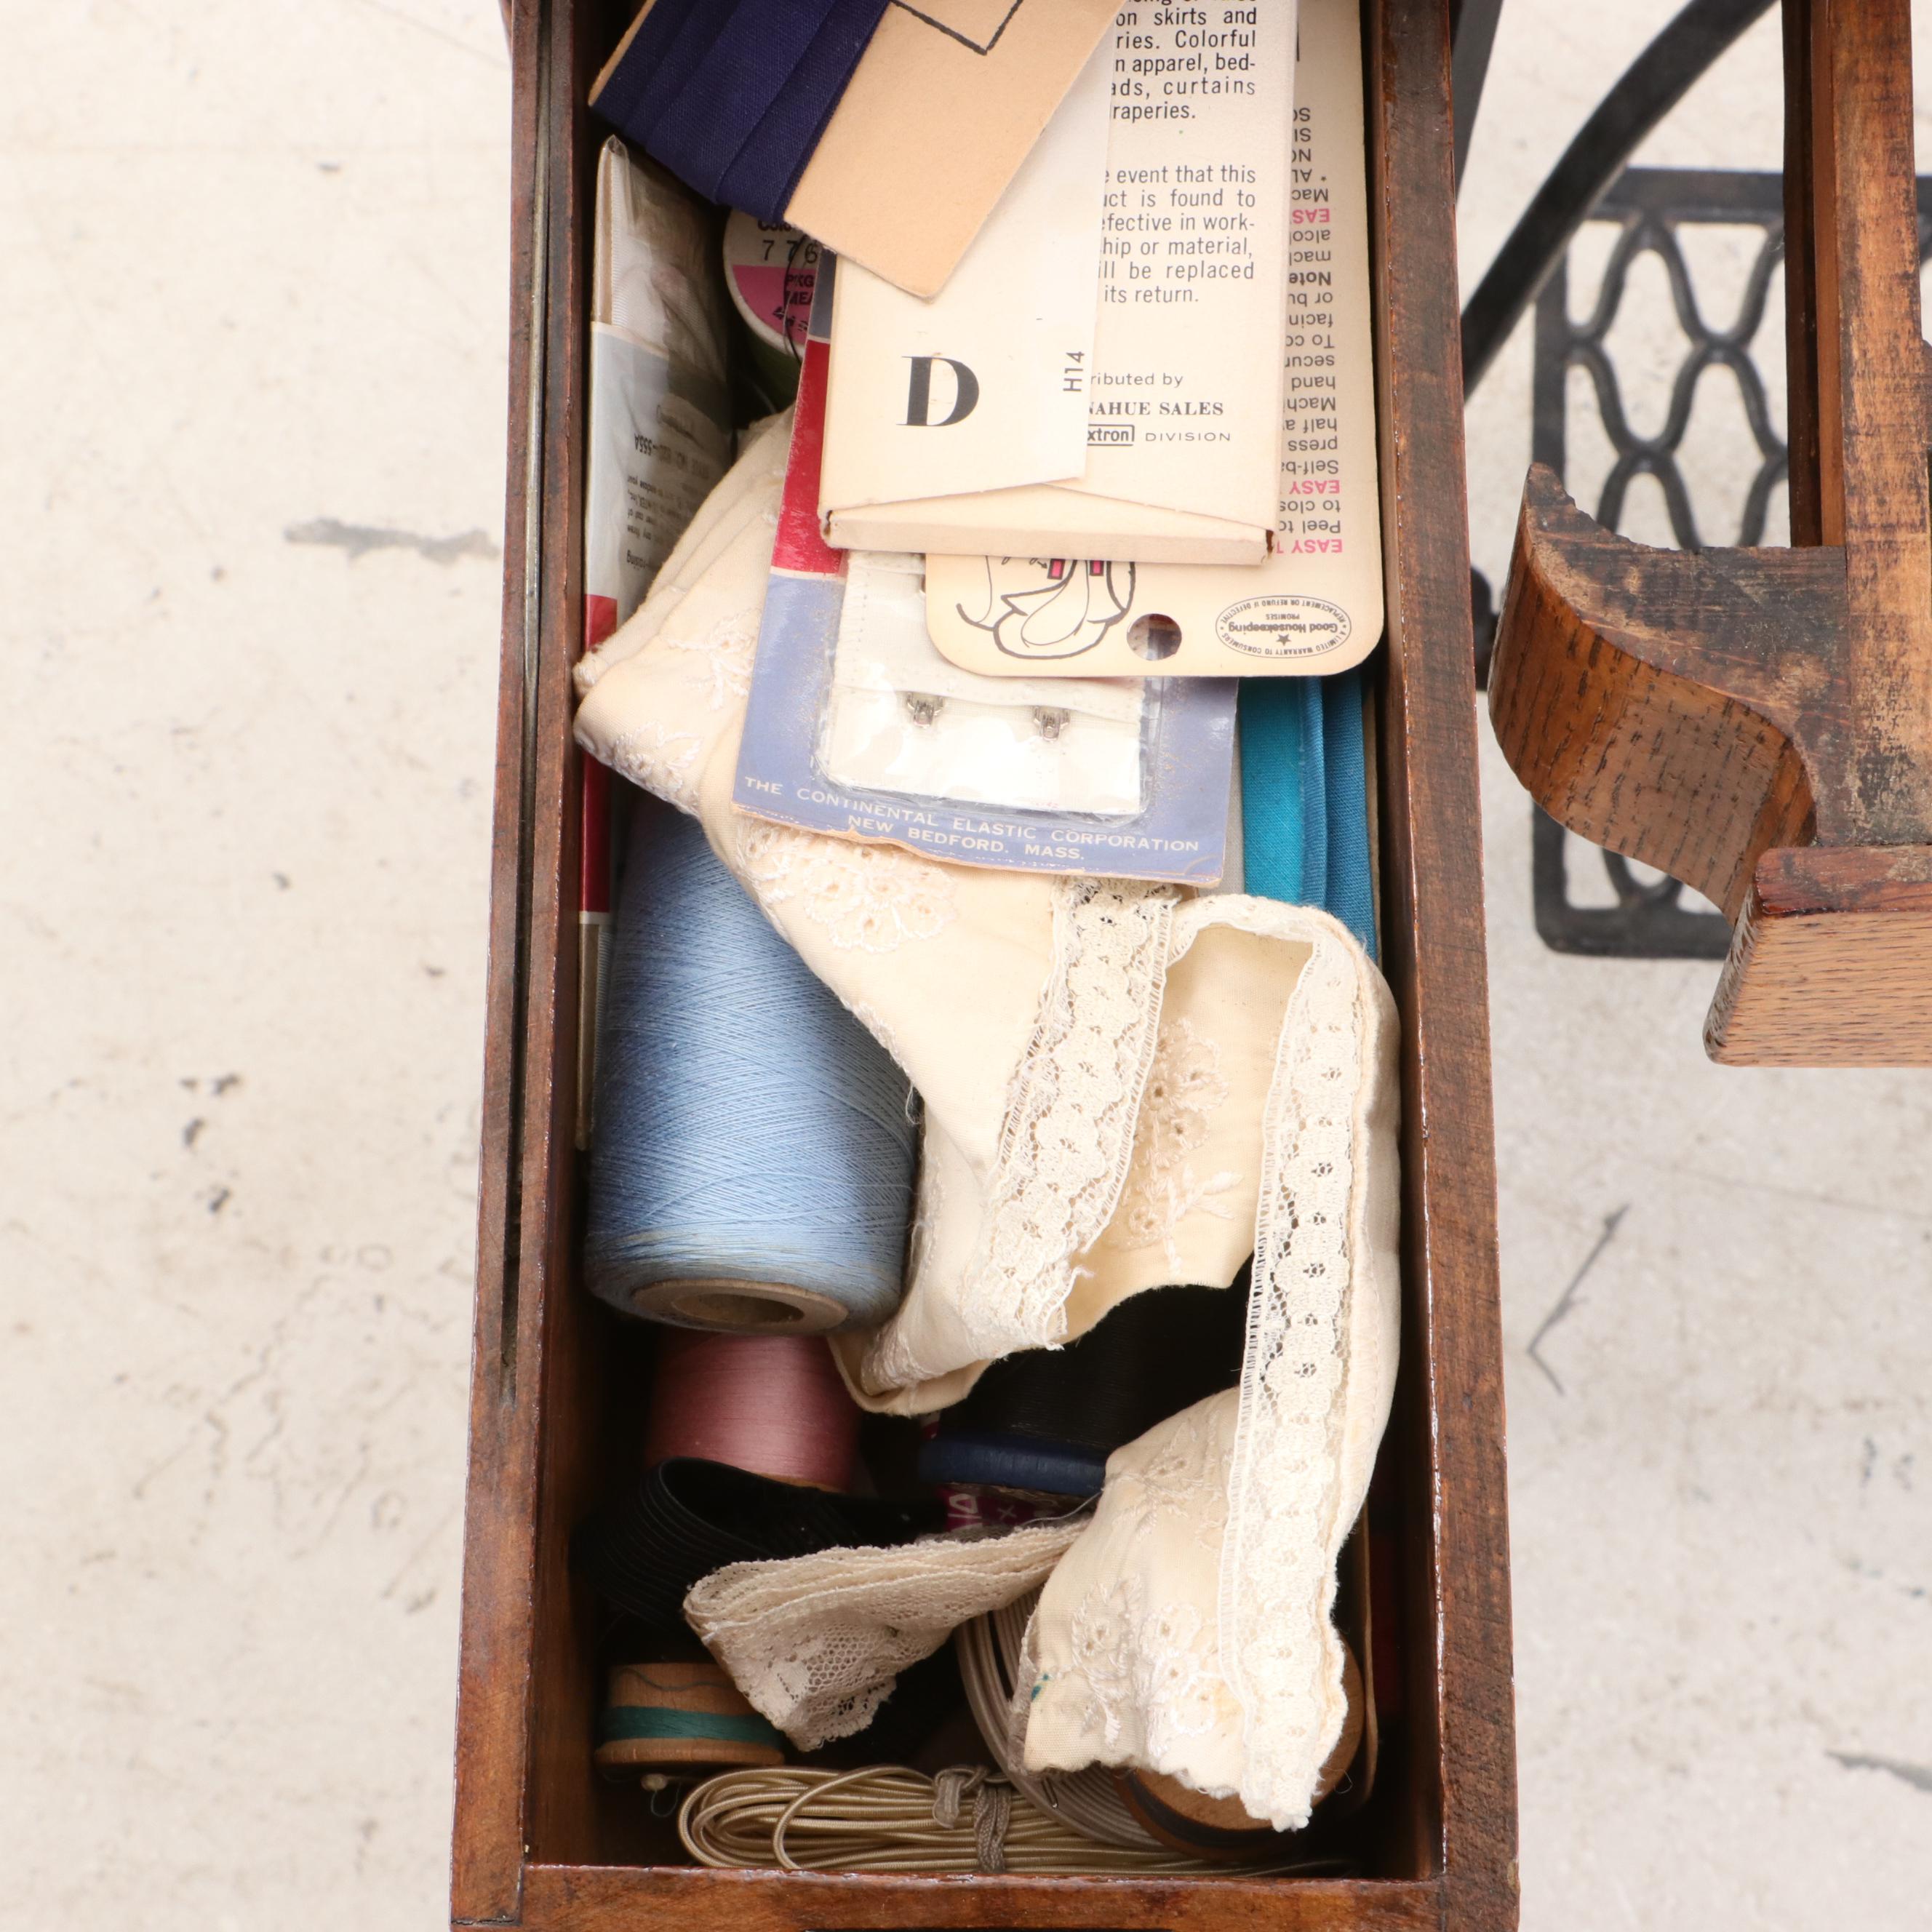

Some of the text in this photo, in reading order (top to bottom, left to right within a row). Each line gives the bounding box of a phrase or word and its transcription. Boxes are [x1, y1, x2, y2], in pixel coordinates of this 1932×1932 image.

[1116, 7, 1257, 26] on skirts and
[1117, 29, 1256, 49] ries. Colorful
[1115, 52, 1256, 76] n apparel, bed-
[1164, 76, 1256, 95] curtains
[1113, 100, 1196, 124] raperies.
[1117, 166, 1168, 183] event
[1175, 164, 1214, 183] that
[1221, 164, 1256, 183] this
[1141, 189, 1157, 207] is
[1170, 188, 1224, 207] found
[1237, 188, 1256, 208] to
[1181, 212, 1196, 231] in
[1203, 212, 1255, 231] work-
[1290, 208, 1330, 224] EAS
[1141, 241, 1159, 255] or
[1168, 236, 1253, 260] material,
[1129, 261, 1151, 279] be
[1166, 260, 1254, 282] replaced
[1104, 284, 1199, 303] its return.
[1315, 292, 1333, 304] or
[1312, 335, 1335, 349] To
[1063, 351, 1085, 392] H14
[1090, 372, 1183, 388] ributed by
[895, 356, 980, 427] D
[1292, 376, 1336, 391] hand
[1159, 402, 1224, 416] SALES
[1283, 397, 1336, 412] Mach
[1304, 418, 1337, 434] half
[1145, 432, 1232, 442] DIVISION
[1288, 436, 1338, 452] press
[1290, 479, 1340, 495] EASY
[1323, 500, 1341, 513] to
[1304, 519, 1341, 534] Peel
[1291, 539, 1343, 554] EASY
[1262, 599, 1288, 607] REFUND
[1302, 599, 1347, 623] REPLACEMENT
[1221, 602, 1252, 624] DEFECTIVE
[1229, 622, 1338, 635] Good Housekeeping
[1221, 632, 1262, 654] CONSUMERS
[1274, 646, 1314, 656] WARRANTY
[745, 776, 1199, 852] THE CONTINENTAL ELASTIC CORPORATION
[848, 814, 895, 834] NEW
[1025, 843, 1085, 861] MASS.
